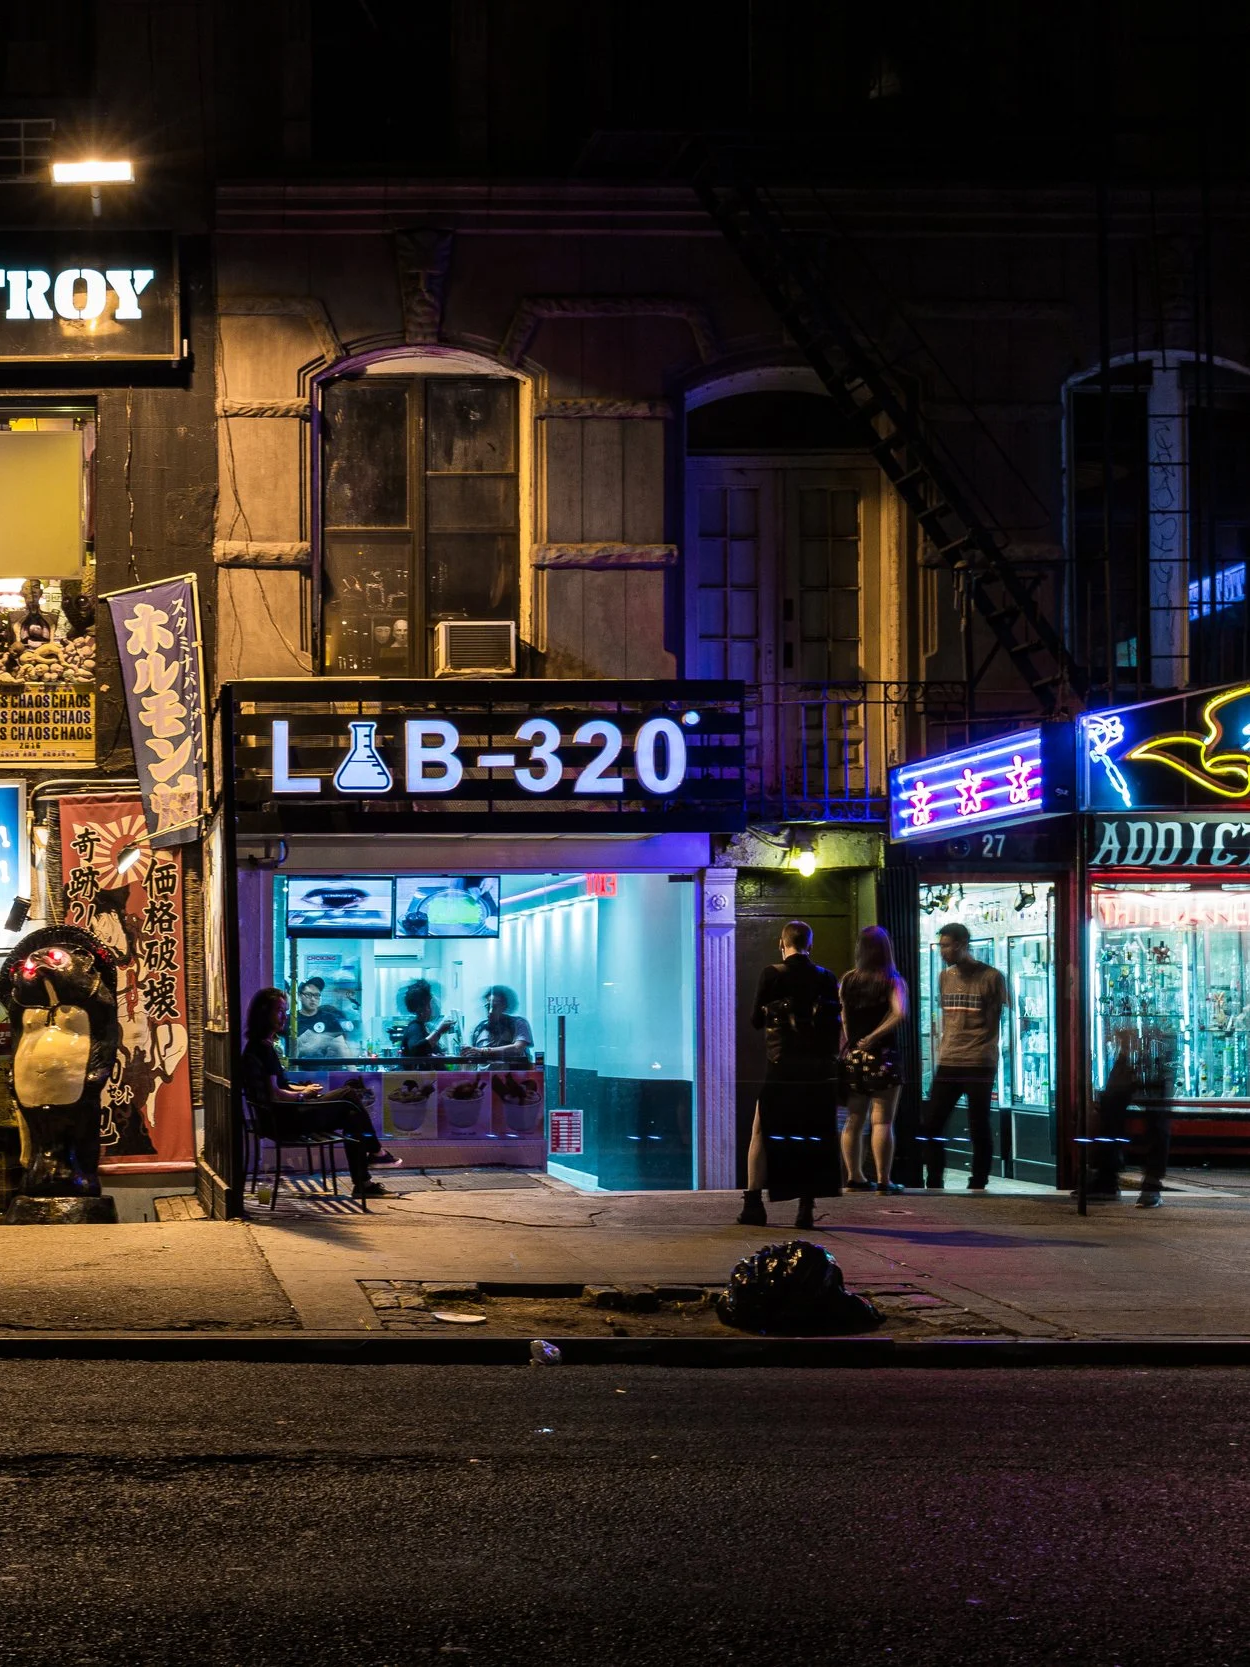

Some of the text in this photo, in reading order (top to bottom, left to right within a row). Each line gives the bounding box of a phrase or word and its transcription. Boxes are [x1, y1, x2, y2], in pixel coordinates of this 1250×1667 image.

[11, 694, 50, 708] CHAOS
[52, 694, 91, 708] CHAOS
[11, 710, 50, 724] CHAOS
[53, 710, 91, 724] CHAOS
[11, 726, 50, 740] CHAOS
[52, 726, 92, 740] CHAOS
[982, 834, 1006, 858] 27
[142, 857, 180, 1020] 価格破壊
[547, 996, 580, 1007] PULL
